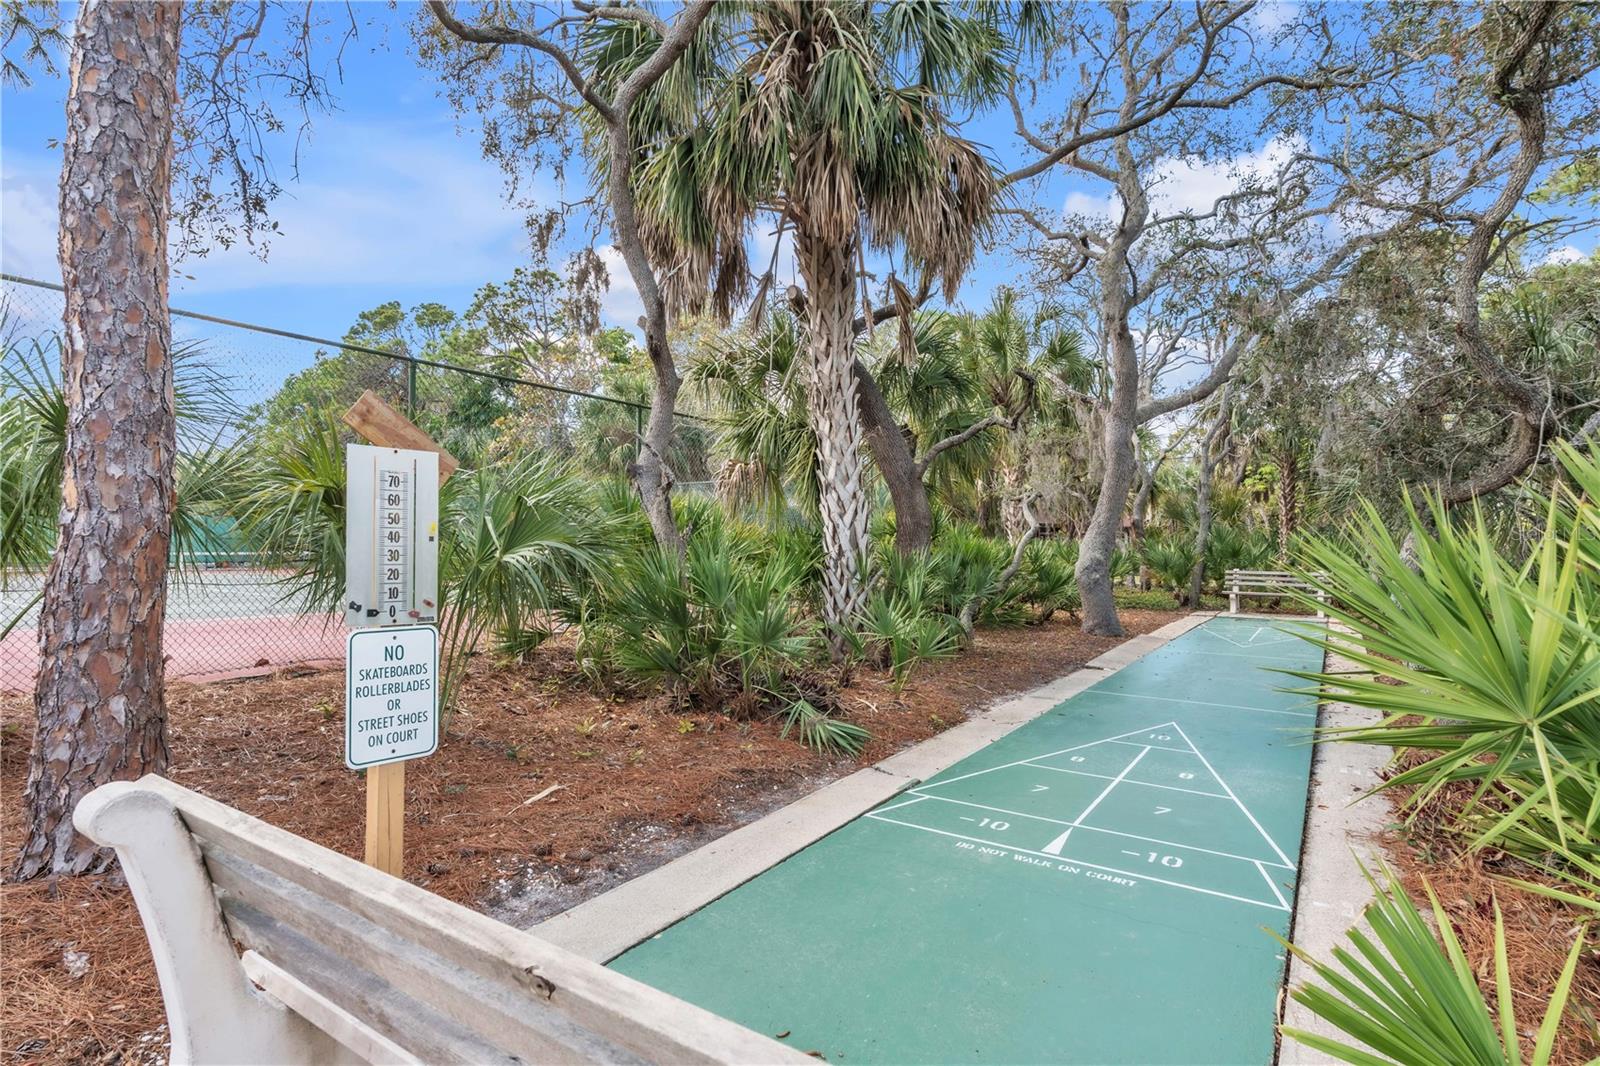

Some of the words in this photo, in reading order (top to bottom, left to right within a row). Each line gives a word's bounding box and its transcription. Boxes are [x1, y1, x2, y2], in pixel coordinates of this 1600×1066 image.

[388, 475, 400, 488] 70
[388, 493, 400, 506] 60
[387, 512, 400, 525] 50
[387, 530, 400, 543] 40
[387, 549, 400, 562] 30
[387, 567, 400, 580] 20
[388, 587, 399, 599] 10
[389, 605, 396, 617] 0
[384, 644, 405, 661] NO
[359, 663, 428, 681] SKATEBOARDS
[355, 679, 431, 698] ROLLERBLADES
[387, 699, 401, 711] OR
[358, 715, 395, 732] STREET
[397, 711, 428, 727] SHOES
[368, 734, 383, 748] ON
[386, 728, 419, 745] COURT
[1149, 733, 1171, 741] 10
[1031, 784, 1050, 792] 7
[1153, 806, 1172, 815] 7
[955, 841, 976, 850] DO
[978, 846, 1009, 857] NOT
[1013, 854, 1053, 868] WALK
[1057, 864, 1081, 875] ON
[1085, 870, 1138, 887] COURT
